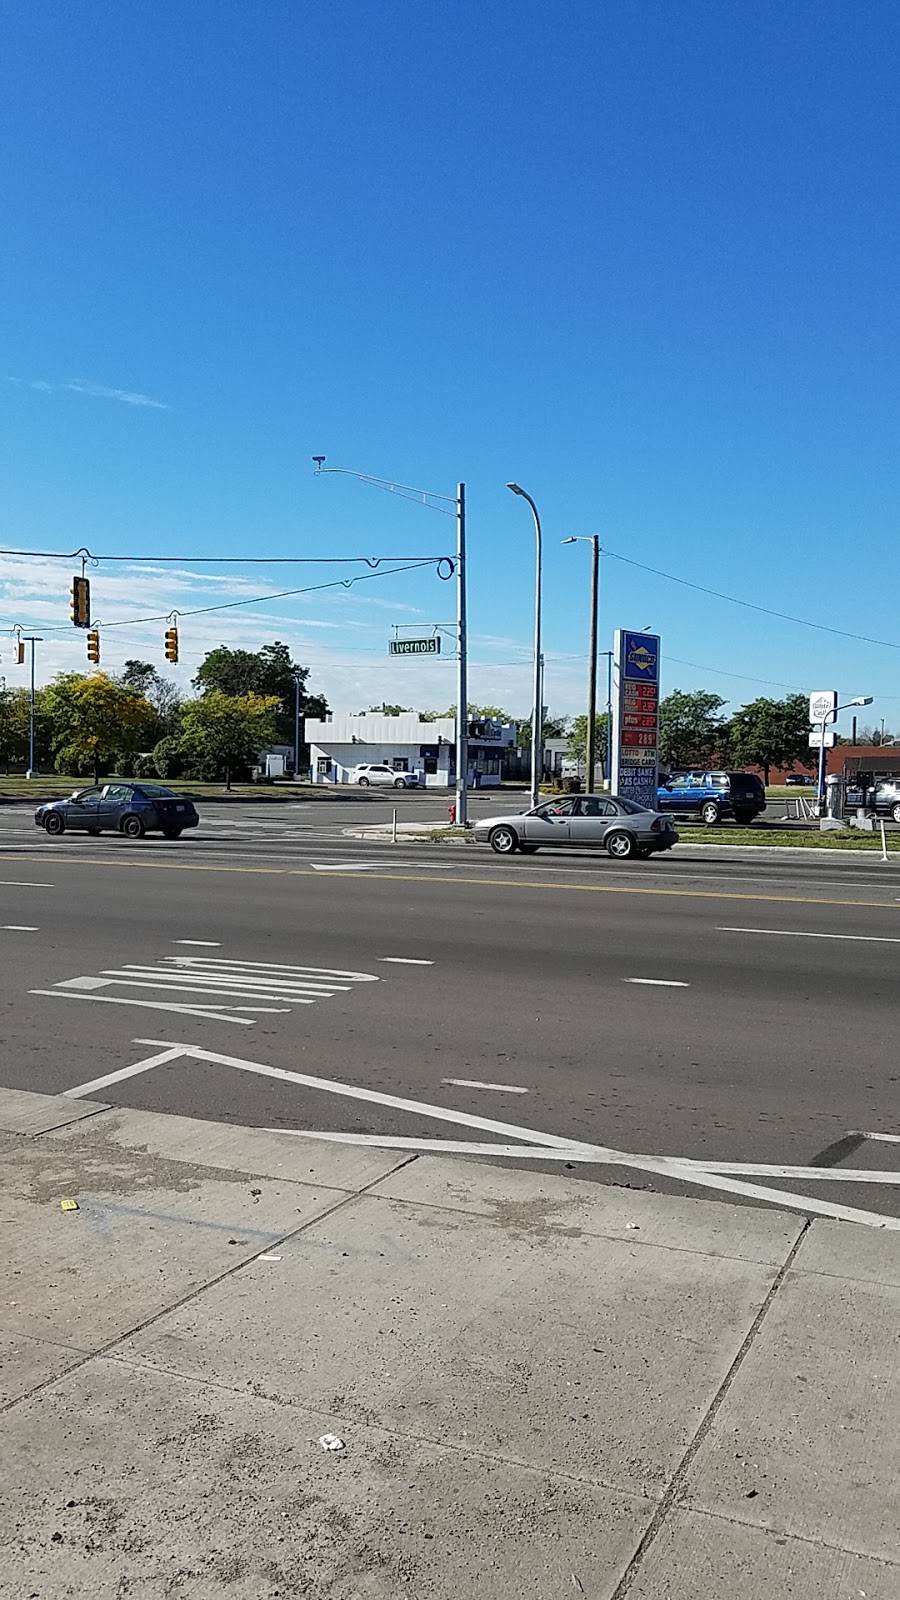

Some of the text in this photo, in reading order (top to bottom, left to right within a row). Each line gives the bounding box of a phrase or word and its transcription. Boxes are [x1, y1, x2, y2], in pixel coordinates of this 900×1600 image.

[391, 640, 434, 654] Livernois
[619, 768, 654, 777] DEBIT SAME
[27, 956, 381, 1025] ONLY
